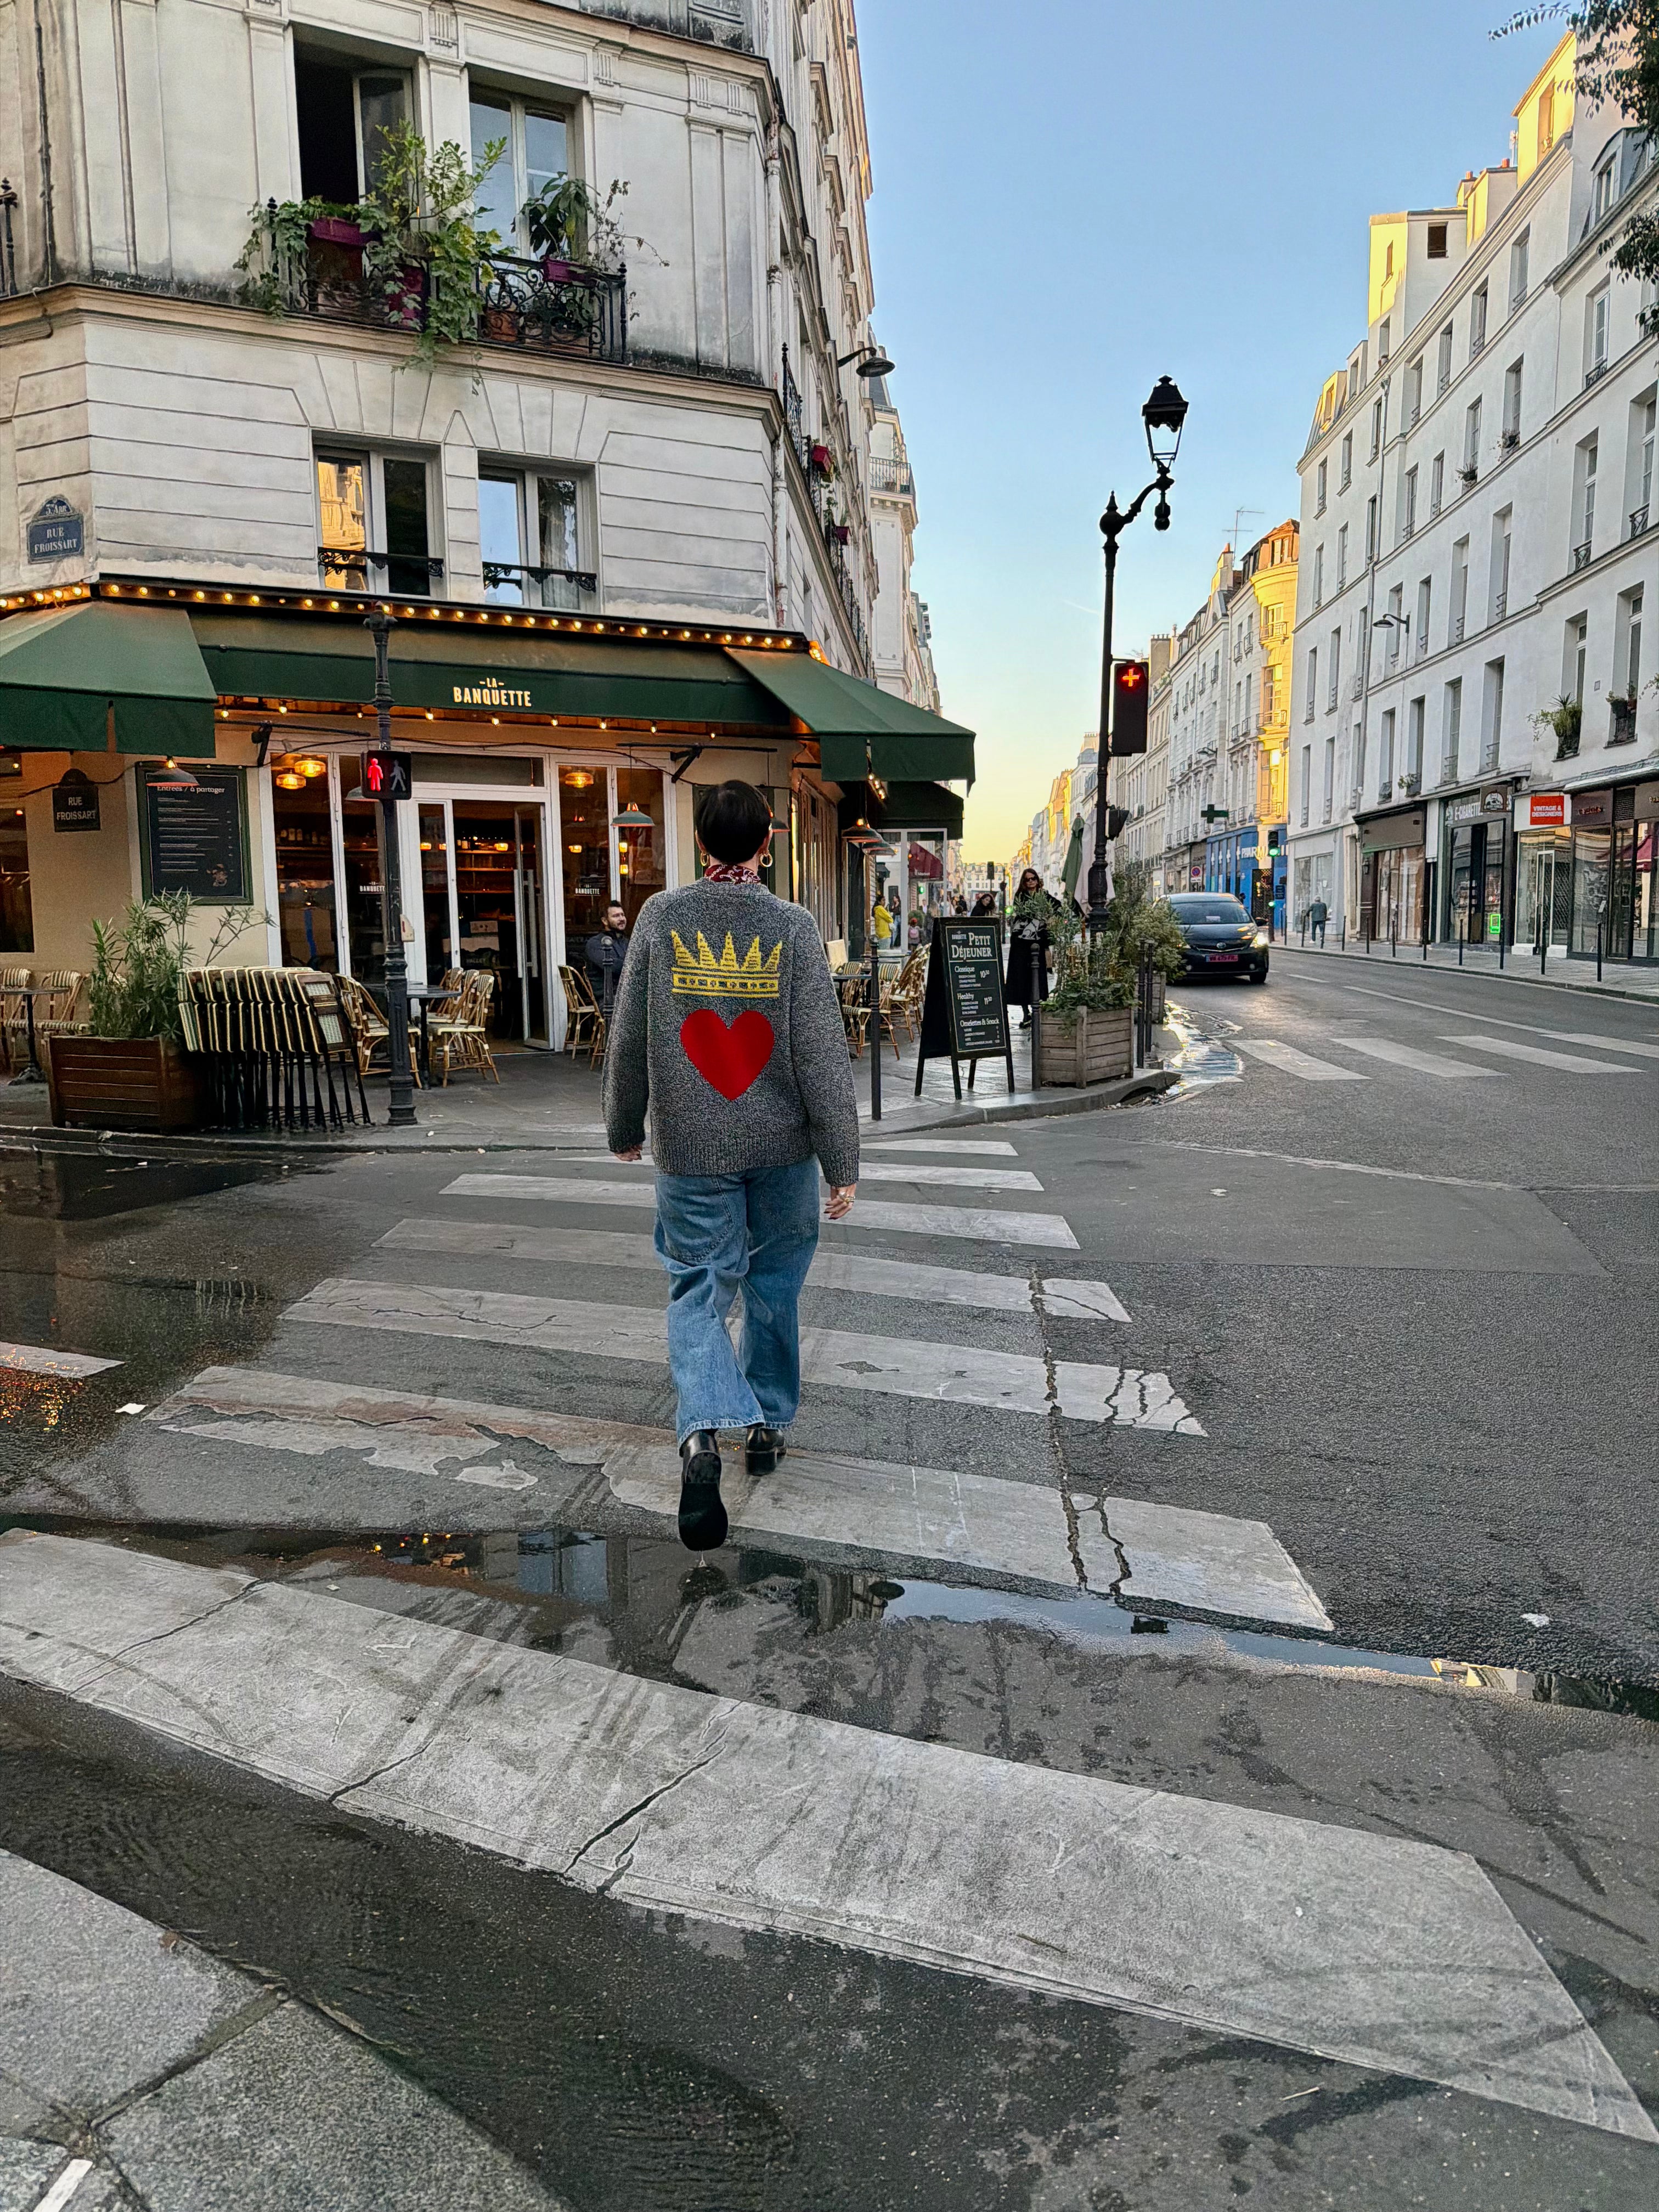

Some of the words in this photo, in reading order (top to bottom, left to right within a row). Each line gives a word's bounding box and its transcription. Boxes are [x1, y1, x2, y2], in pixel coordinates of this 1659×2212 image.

[47, 527, 64, 538] RUE
[35, 539, 77, 554] FROISSART
[453, 687, 532, 707] BANQUETTE
[69, 797, 83, 806] RUE
[57, 810, 96, 821] FROISSART
[1241, 845, 1289, 859] PHARMI
[968, 932, 991, 945] PETIT
[951, 944, 992, 960] DÉJEUNER
[957, 992, 974, 1001] Healthy
